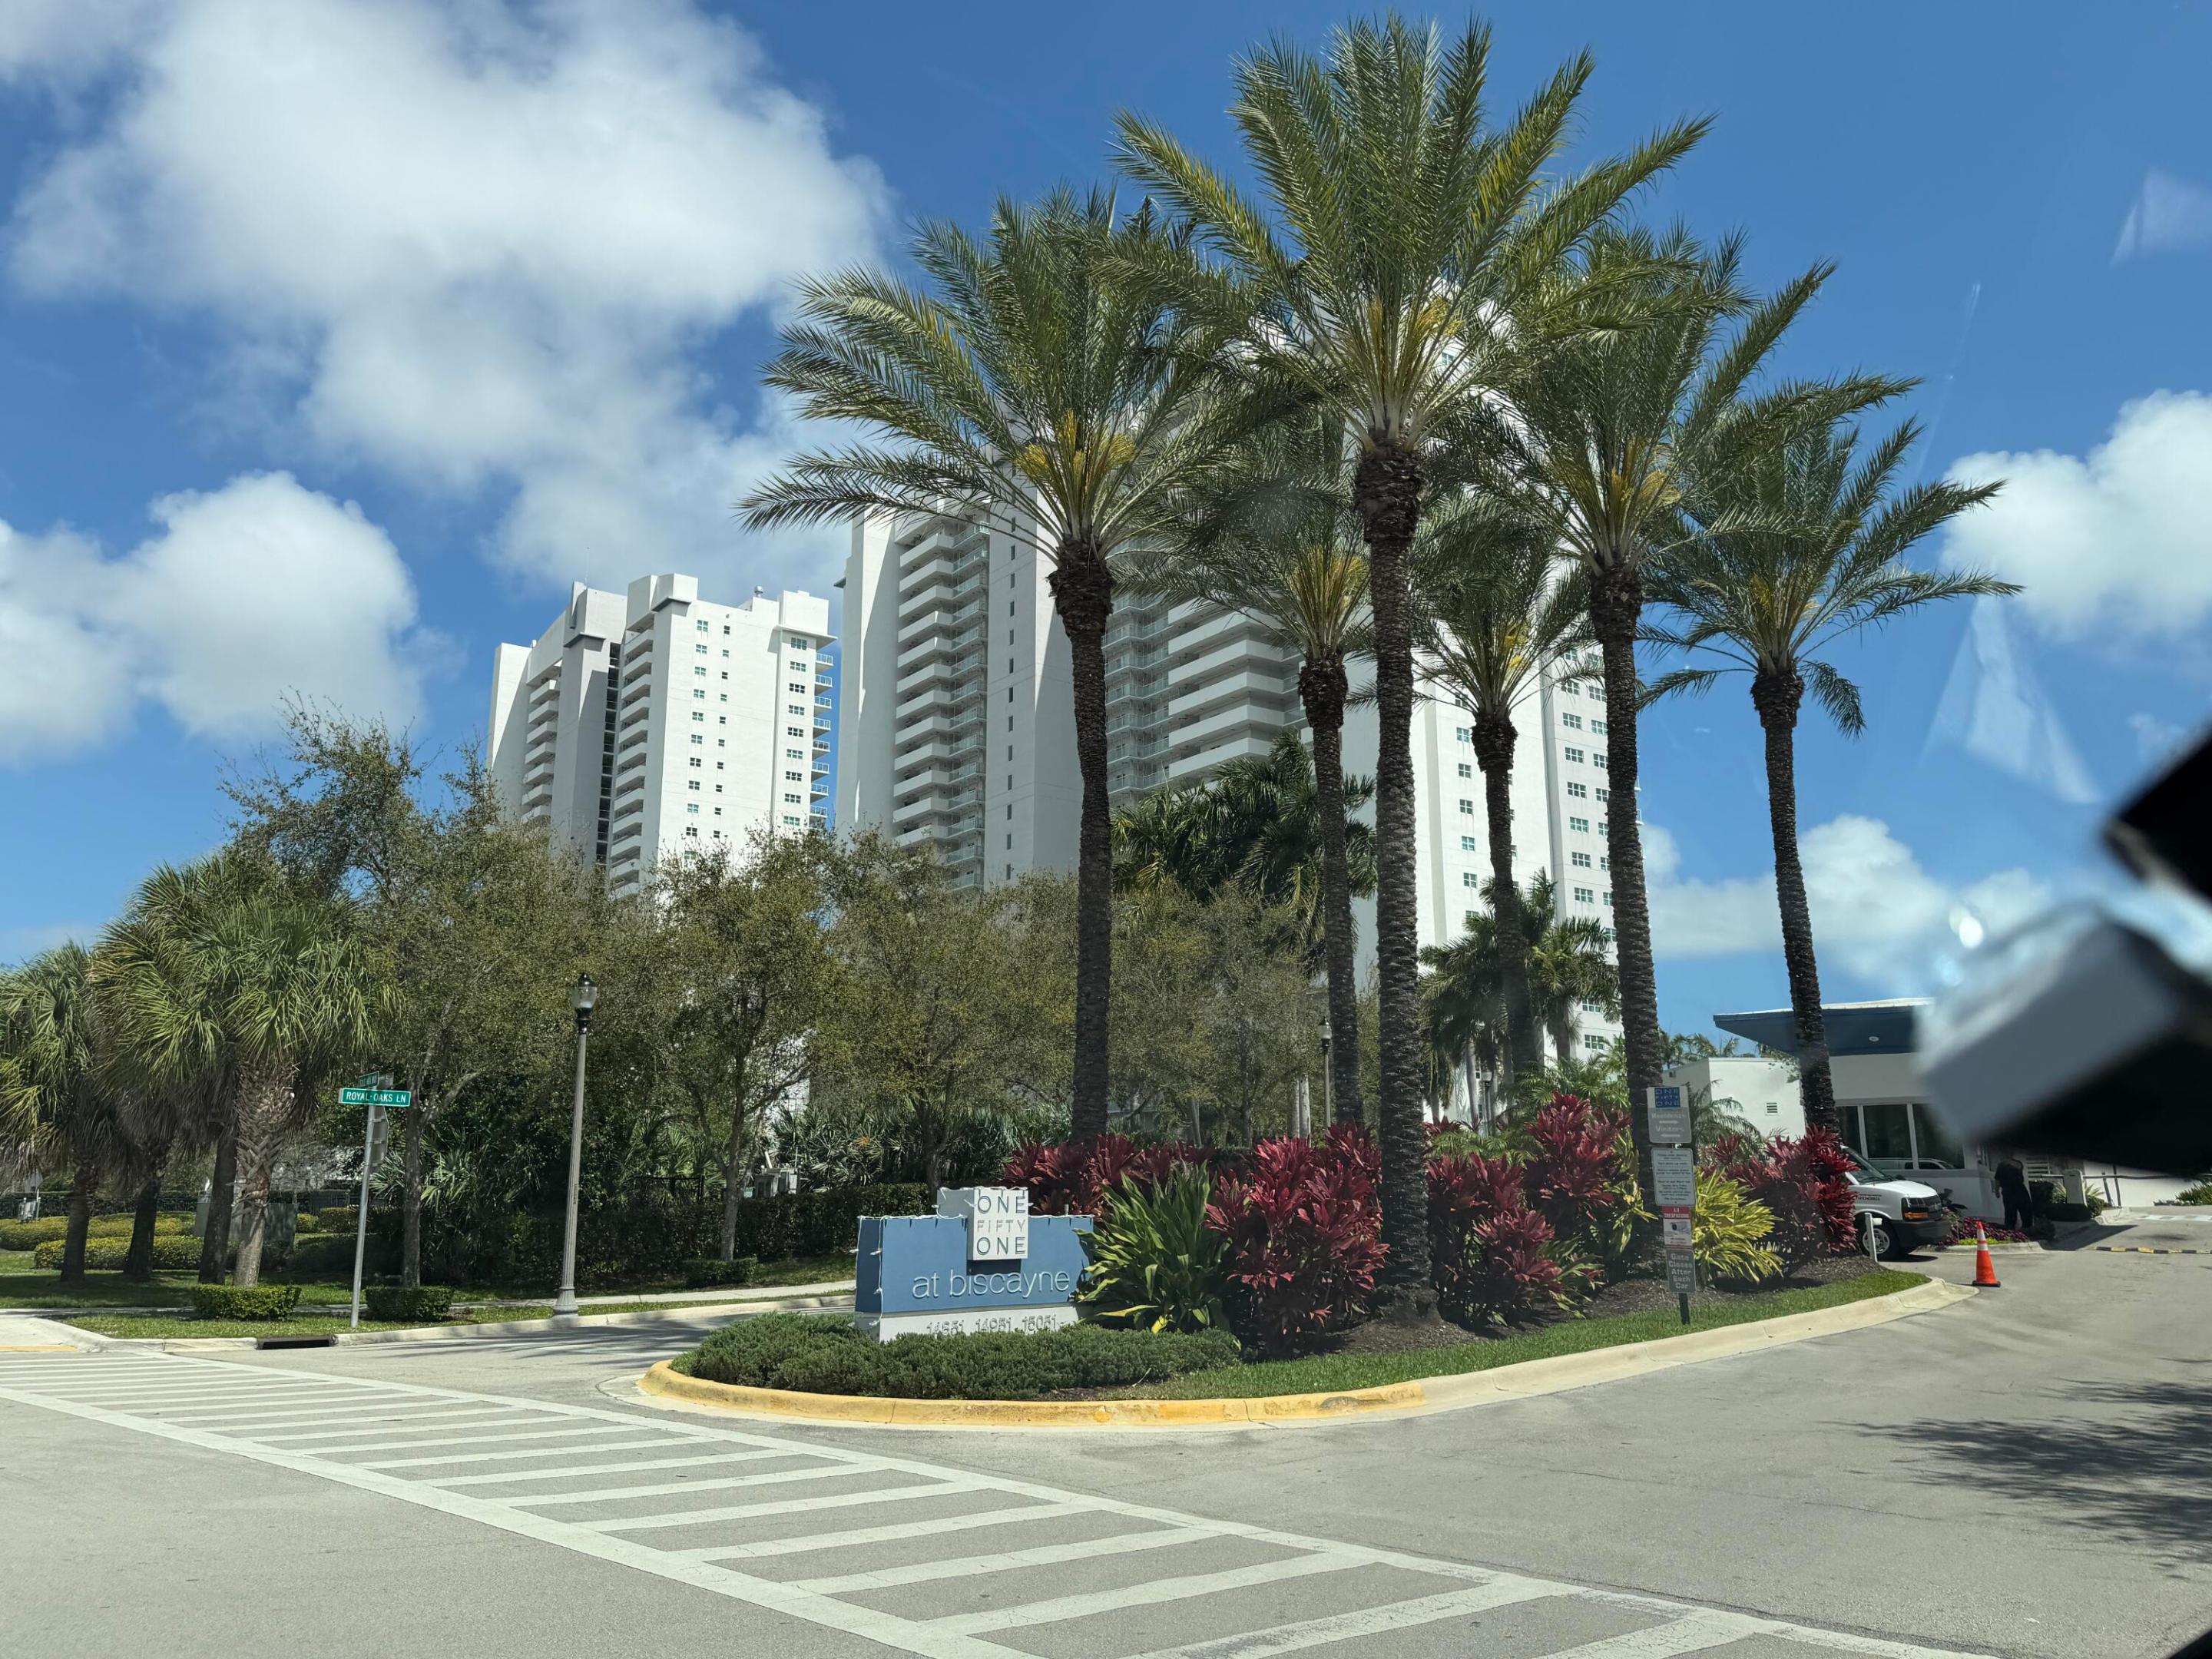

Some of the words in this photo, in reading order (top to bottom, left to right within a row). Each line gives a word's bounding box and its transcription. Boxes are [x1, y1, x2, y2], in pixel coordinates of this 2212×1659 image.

[346, 1091, 369, 1101] ROYAL
[373, 1093, 393, 1103] OAKS
[396, 1094, 406, 1104] LN
[977, 1195, 1026, 1214] ONE
[977, 1219, 1026, 1233] FIFTY
[976, 1237, 1026, 1256] ONE
[912, 1270, 940, 1300] at
[949, 1269, 1071, 1300] biscayne
